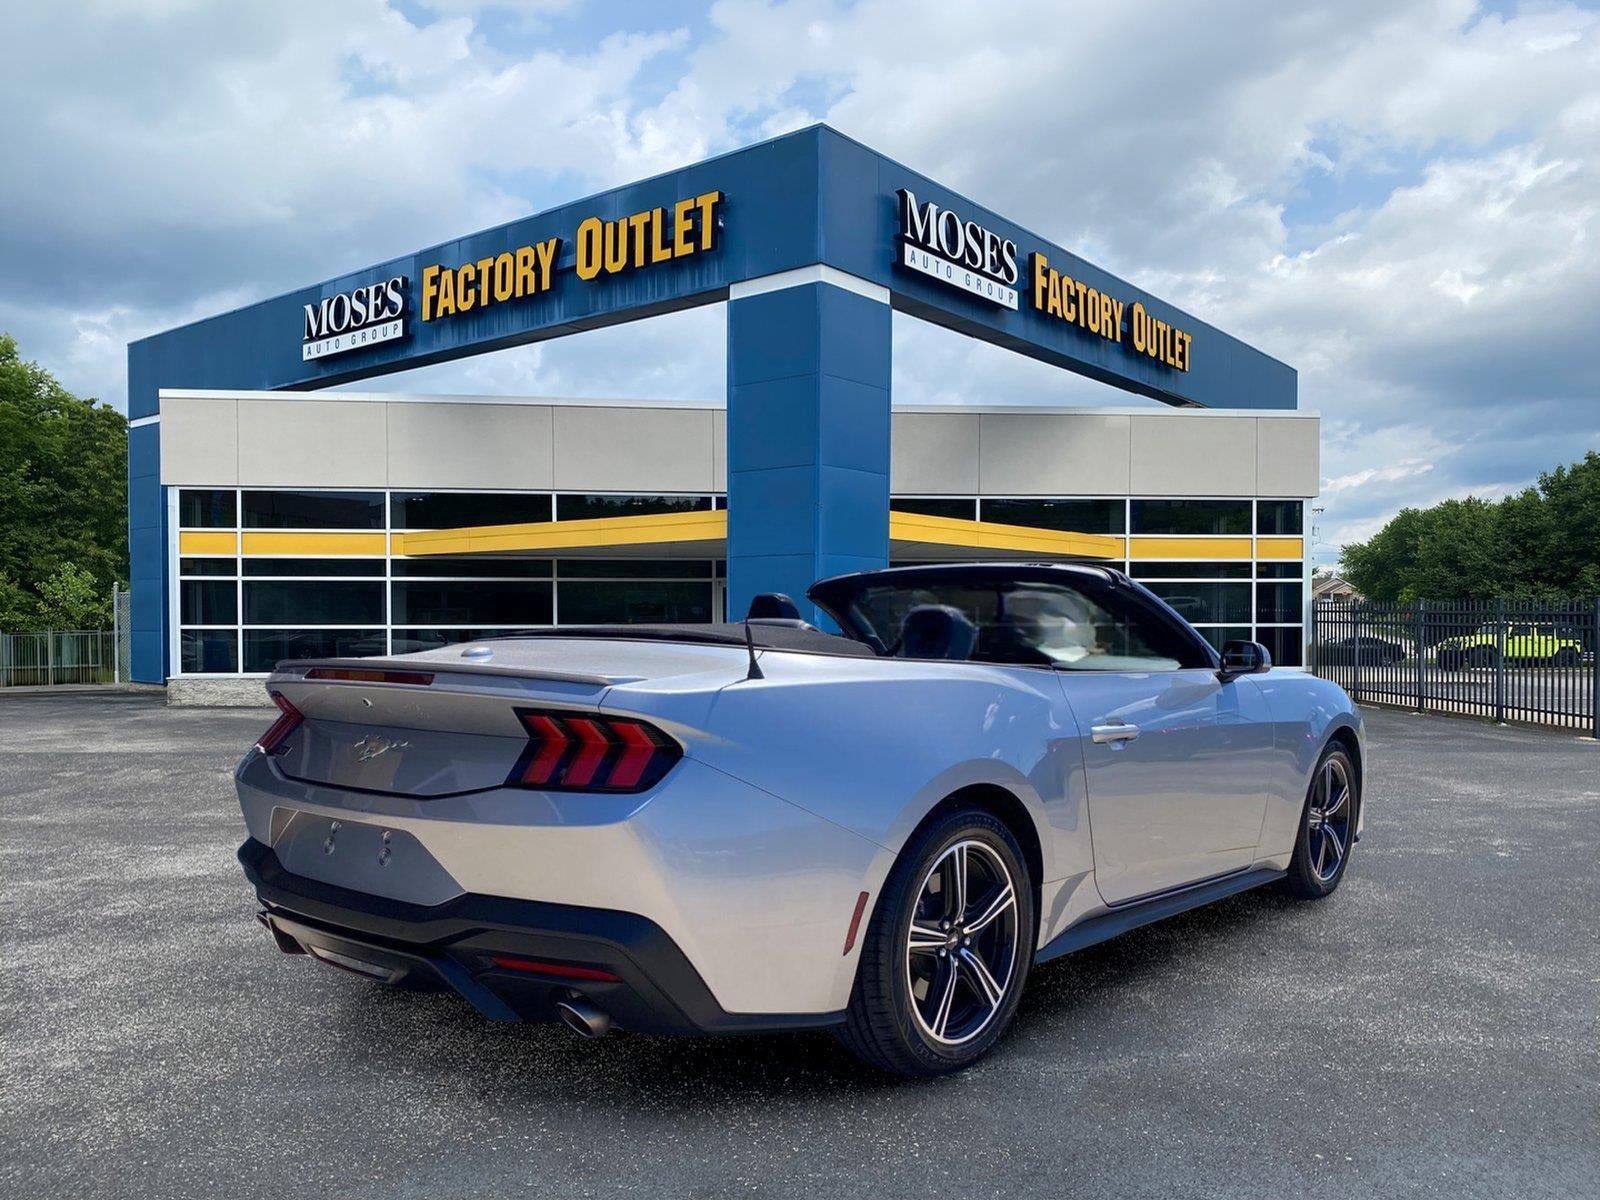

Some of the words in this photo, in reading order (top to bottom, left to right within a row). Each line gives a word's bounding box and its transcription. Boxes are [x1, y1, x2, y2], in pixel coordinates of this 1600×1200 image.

[422, 237, 557, 322] FACTORY
[576, 190, 720, 281] OUTLET
[903, 188, 1018, 285] MOSES
[910, 250, 952, 279] AUTO
[965, 273, 1014, 303] GROUP
[303, 276, 403, 340] MOSES
[307, 338, 340, 356] AUTO
[350, 323, 399, 346] GROUP
[1034, 251, 1124, 343] FACTORY
[1132, 301, 1192, 372] OUTLET
